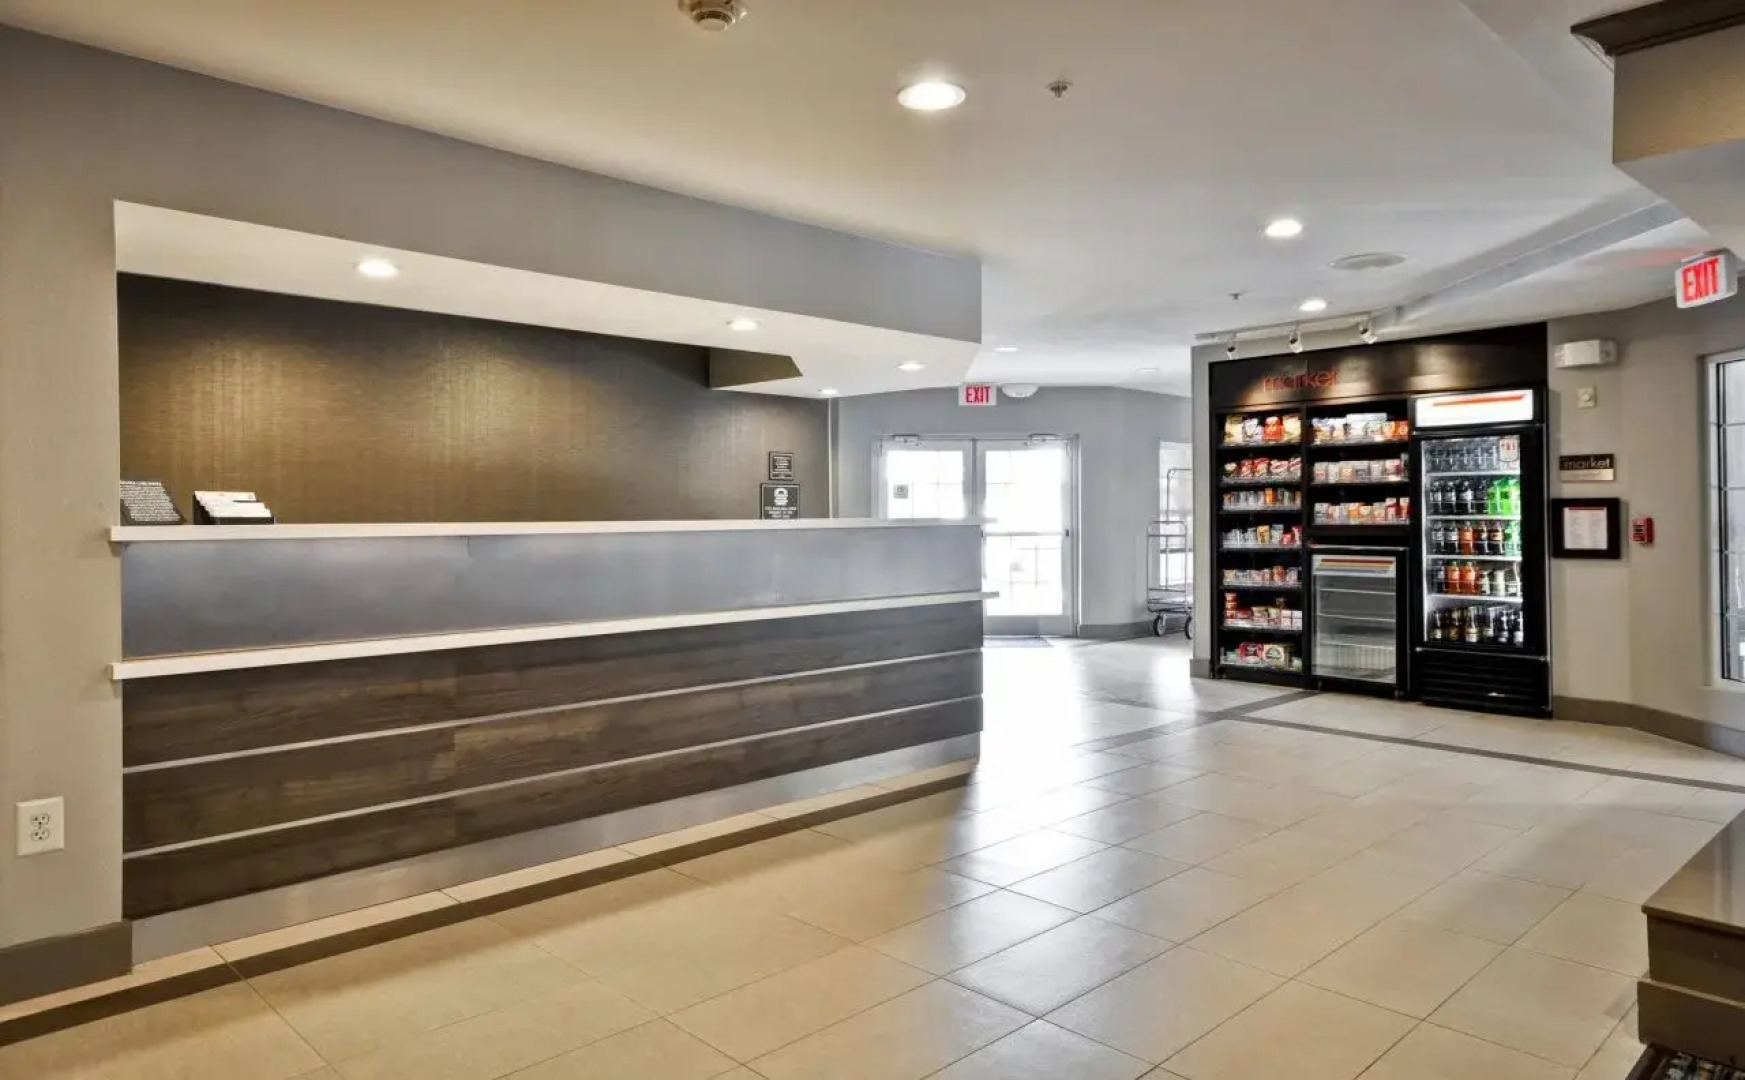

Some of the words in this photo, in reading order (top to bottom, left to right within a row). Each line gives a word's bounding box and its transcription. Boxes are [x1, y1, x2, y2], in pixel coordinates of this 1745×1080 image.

[1682, 257, 1720, 302] EXIT
[1262, 365, 1337, 393] market
[965, 385, 992, 403] EXIT
[1563, 457, 1610, 469] market
